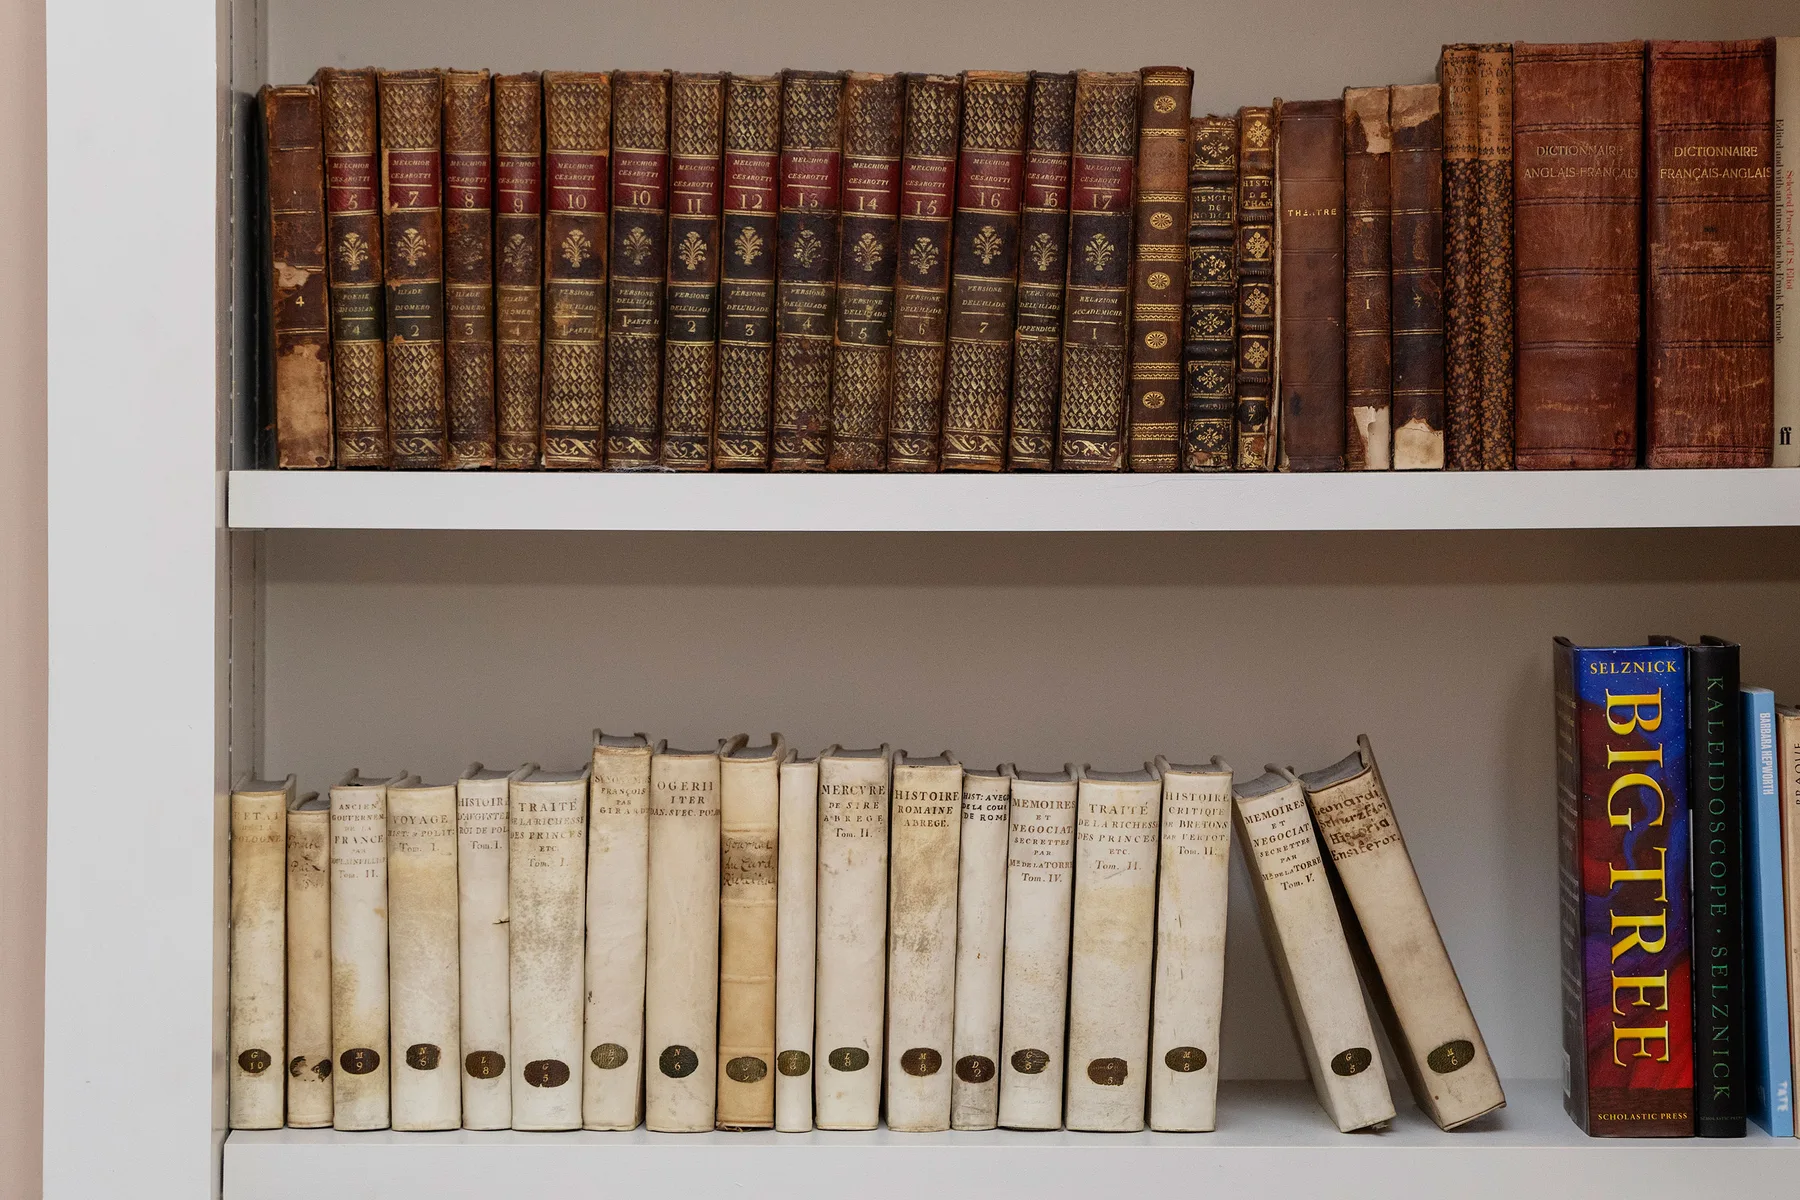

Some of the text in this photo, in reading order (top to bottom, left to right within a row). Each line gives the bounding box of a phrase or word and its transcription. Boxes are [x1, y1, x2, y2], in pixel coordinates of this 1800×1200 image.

[1537, 145, 1623, 157] DICTIONNAIRE
[1674, 146, 1758, 157] DICTIONNAIRE
[732, 174, 772, 182] CESAROTTI
[971, 175, 1010, 183] CESAROTTI
[1524, 167, 1638, 181] ANGLAIS-FRANÇAIS
[1660, 167, 1772, 181] FRANÇAIS-ANGLAIS
[348, 195, 358, 210] 5
[409, 191, 419, 205] 7
[464, 193, 474, 208] 8
[567, 194, 587, 209] 10
[632, 190, 651, 205] 10
[741, 194, 763, 209] 12
[798, 193, 818, 208] 13
[858, 196, 878, 210] 14
[979, 192, 1000, 207] 16
[1093, 194, 1112, 209] 17
[514, 199, 523, 213] 9
[687, 199, 702, 213] 11
[916, 200, 937, 215] 15
[1786, 210, 1794, 234] Prose
[1775, 119, 1784, 344] Edited and with an Introduction by Frank Kermode
[1786, 268, 1794, 290] Eliot
[296, 296, 304, 307] 4
[687, 321, 696, 332] 2
[803, 319, 811, 328] 4
[919, 323, 926, 335] 6
[979, 322, 988, 333] 7
[353, 326, 360, 336] 4
[411, 325, 419, 336] 2
[465, 324, 473, 335] 3
[745, 324, 754, 336] 3
[858, 328, 867, 339] 5
[1779, 427, 1792, 445] ff
[1590, 661, 1676, 674] SELZNICK
[1760, 713, 1774, 794] BARBARA HEPWORTH
[658, 782, 713, 791] OGERII
[822, 785, 886, 795] MERCVRE
[671, 796, 705, 804] ITER
[895, 790, 959, 801] HISTOIRE
[1165, 792, 1228, 802] HISTOIRE
[1707, 676, 1726, 917] KALEIDOSCOPE
[1012, 798, 1076, 809] MEMOIRES
[1089, 802, 1148, 815] TRAITÉ
[898, 806, 953, 814] ROMAINE
[1245, 798, 1305, 825] MEMOIRES
[393, 815, 448, 824] VOYAGE
[1093, 820, 1108, 828] LA
[1180, 820, 1228, 828] BRETONS
[1272, 820, 1285, 829] ET
[835, 828, 856, 838] Tom.
[1012, 824, 1073, 834] NEGOCIAT.
[1253, 822, 1312, 847] NEGOCIAT.
[1014, 837, 1069, 846] SECRETTES
[1177, 846, 1217, 855] Tom. II.
[1260, 837, 1310, 858] SECRETTES
[1280, 854, 1297, 863] PAR
[1293, 856, 1321, 872] TORRE
[1095, 860, 1141, 870] Tom. II.
[1022, 872, 1062, 882] Tom. IV.
[1280, 873, 1315, 891] Tom. V.
[1605, 687, 1668, 1067] BIG TREE
[1710, 946, 1730, 1101] SELZNICK
[1346, 1053, 1352, 1061] G
[1451, 1057, 1458, 1065] 6
[357, 1062, 362, 1070] 9
[675, 1062, 681, 1070] 6
[920, 1064, 926, 1072] 8
[1184, 1063, 1190, 1071] 8
[543, 1074, 548, 1082] 5
[975, 1069, 981, 1077] 2
[1777, 1081, 1789, 1112] TATE
[1598, 1112, 1688, 1121] SCHOLASTIC PRESS
